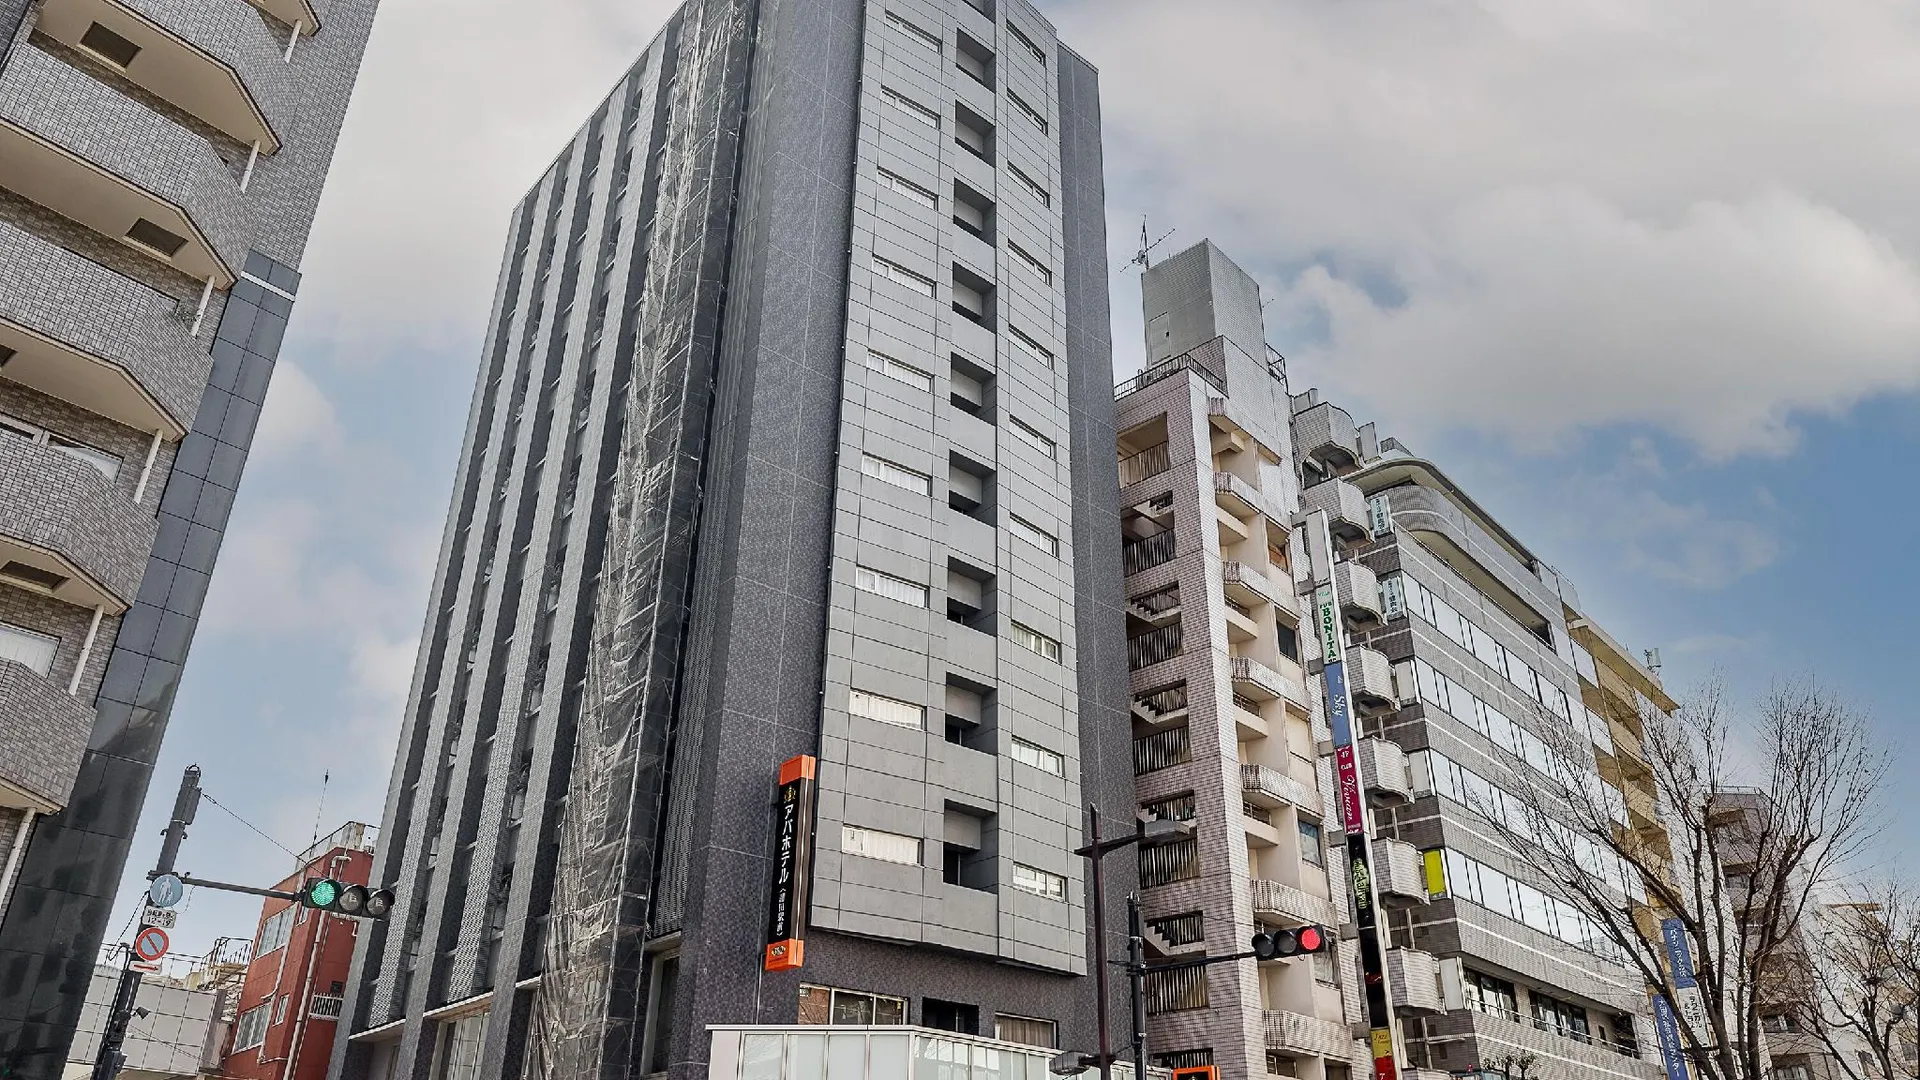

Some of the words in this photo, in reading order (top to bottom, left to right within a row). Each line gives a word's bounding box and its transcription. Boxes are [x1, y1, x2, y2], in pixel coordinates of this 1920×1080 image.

[1323, 608, 1336, 658] BONITA
[1332, 694, 1345, 717] Sky
[778, 803, 794, 885] アパホテル
